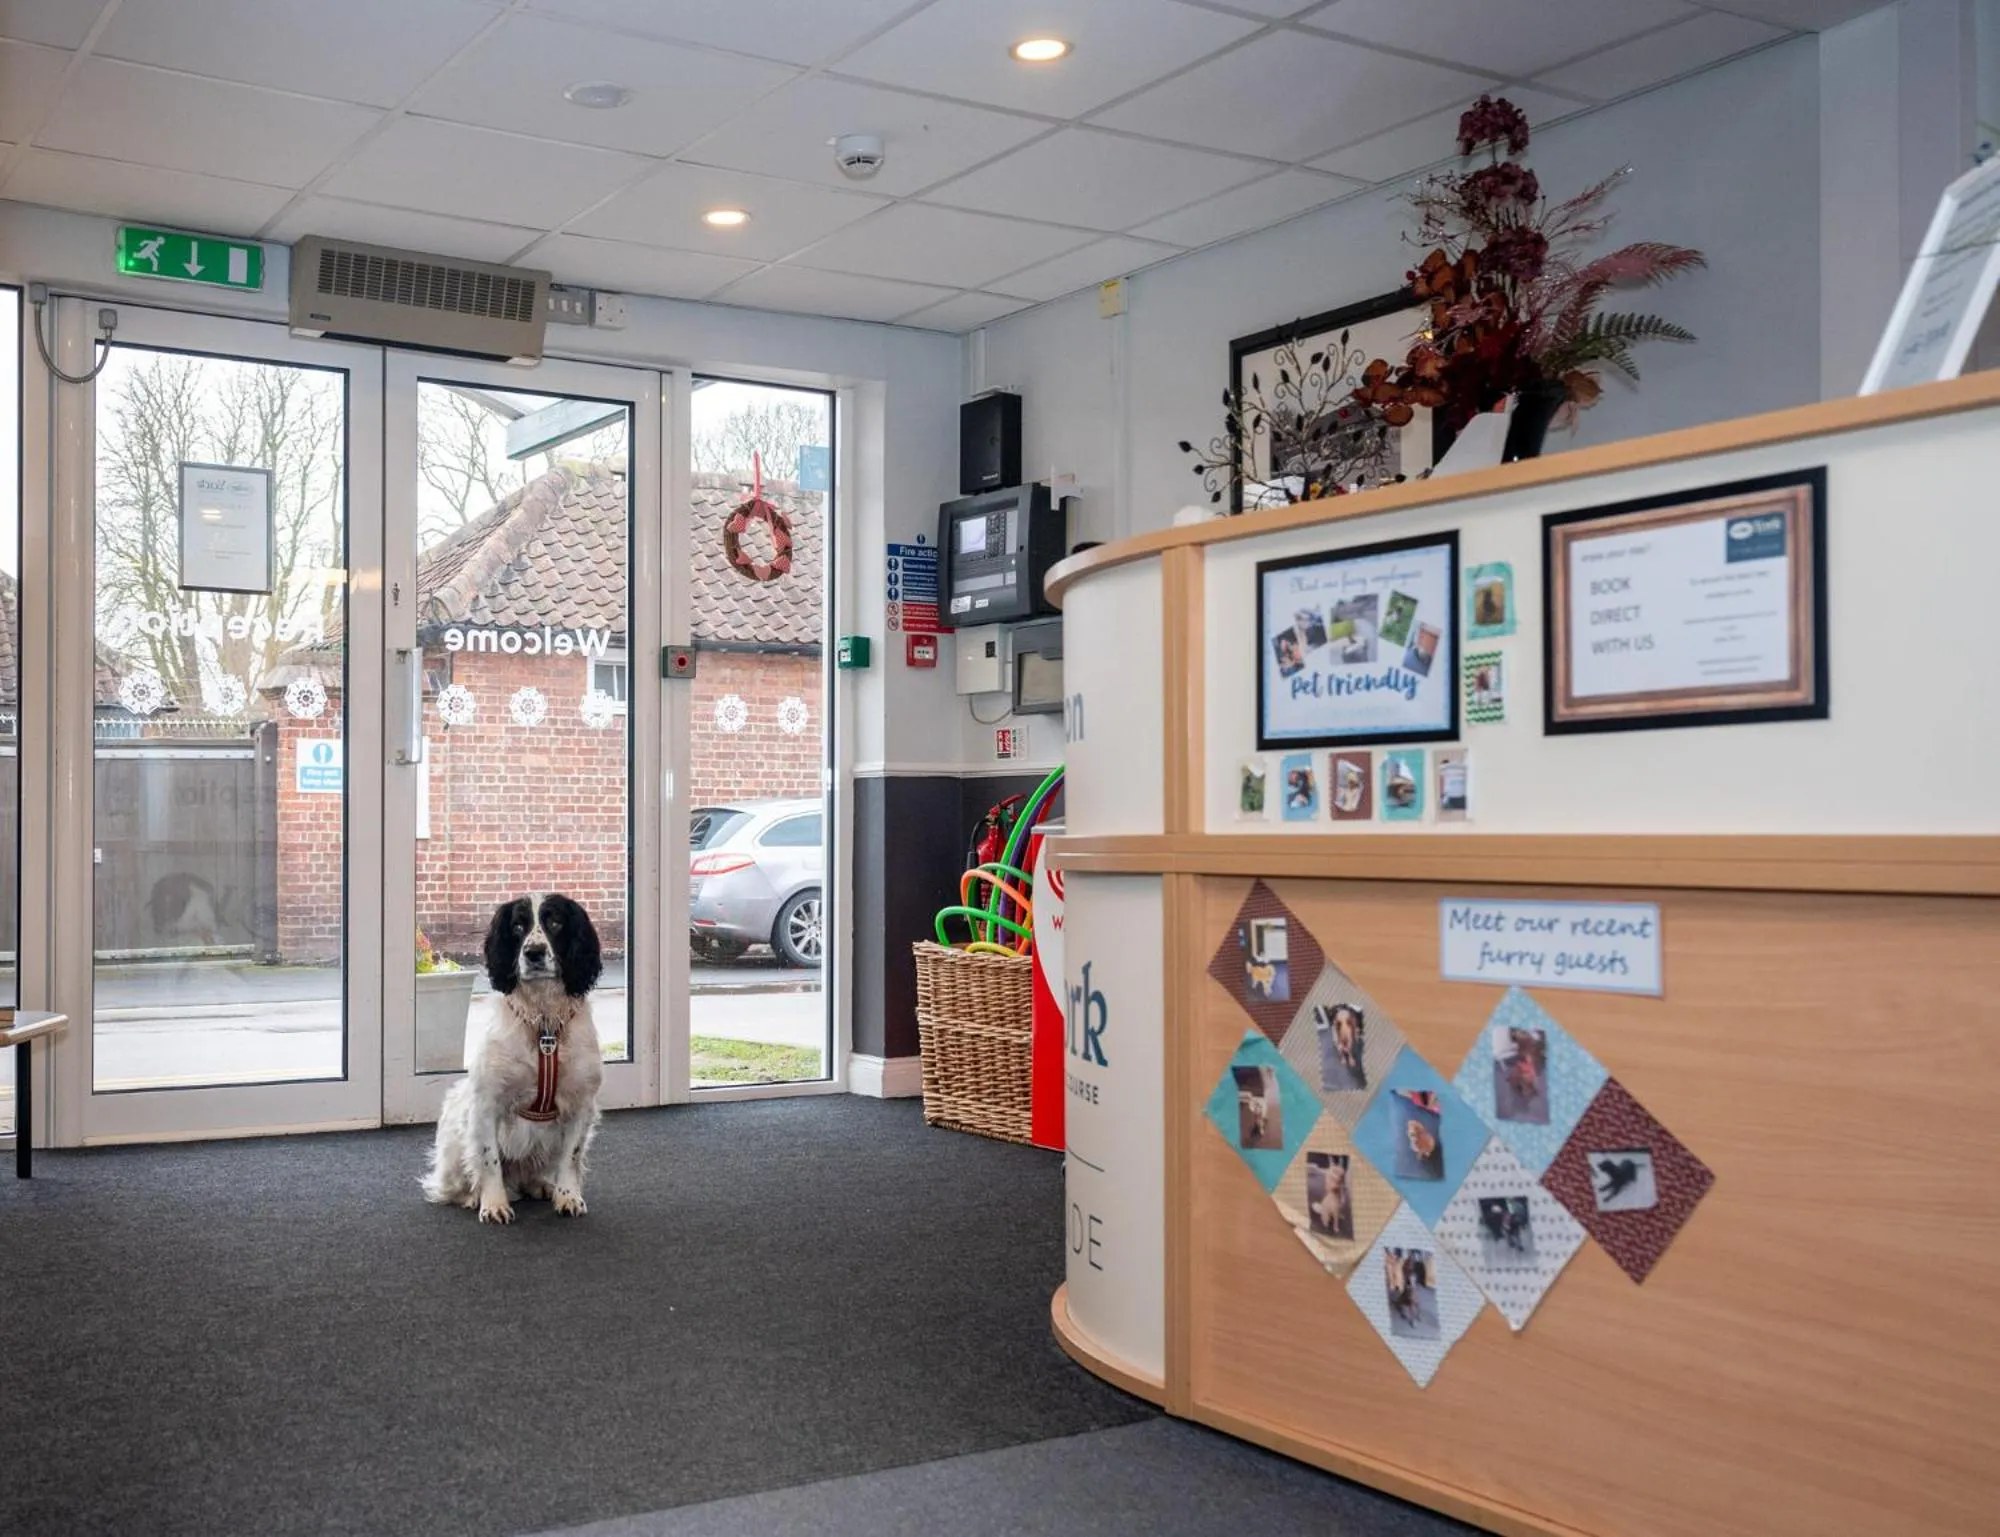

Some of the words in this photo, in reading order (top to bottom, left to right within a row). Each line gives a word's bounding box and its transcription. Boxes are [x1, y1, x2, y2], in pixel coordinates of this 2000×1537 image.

[899, 545, 916, 556] Fire
[1590, 577, 1631, 596] BOOK
[1590, 605, 1641, 626] DIRECT
[1591, 637, 1631, 655] WITH
[1634, 634, 1655, 651] US
[1449, 907, 1507, 931] Meet
[1514, 915, 1560, 934] our
[1570, 917, 1653, 938] recent
[1477, 941, 1545, 974] furry
[1554, 950, 1629, 976] guests
